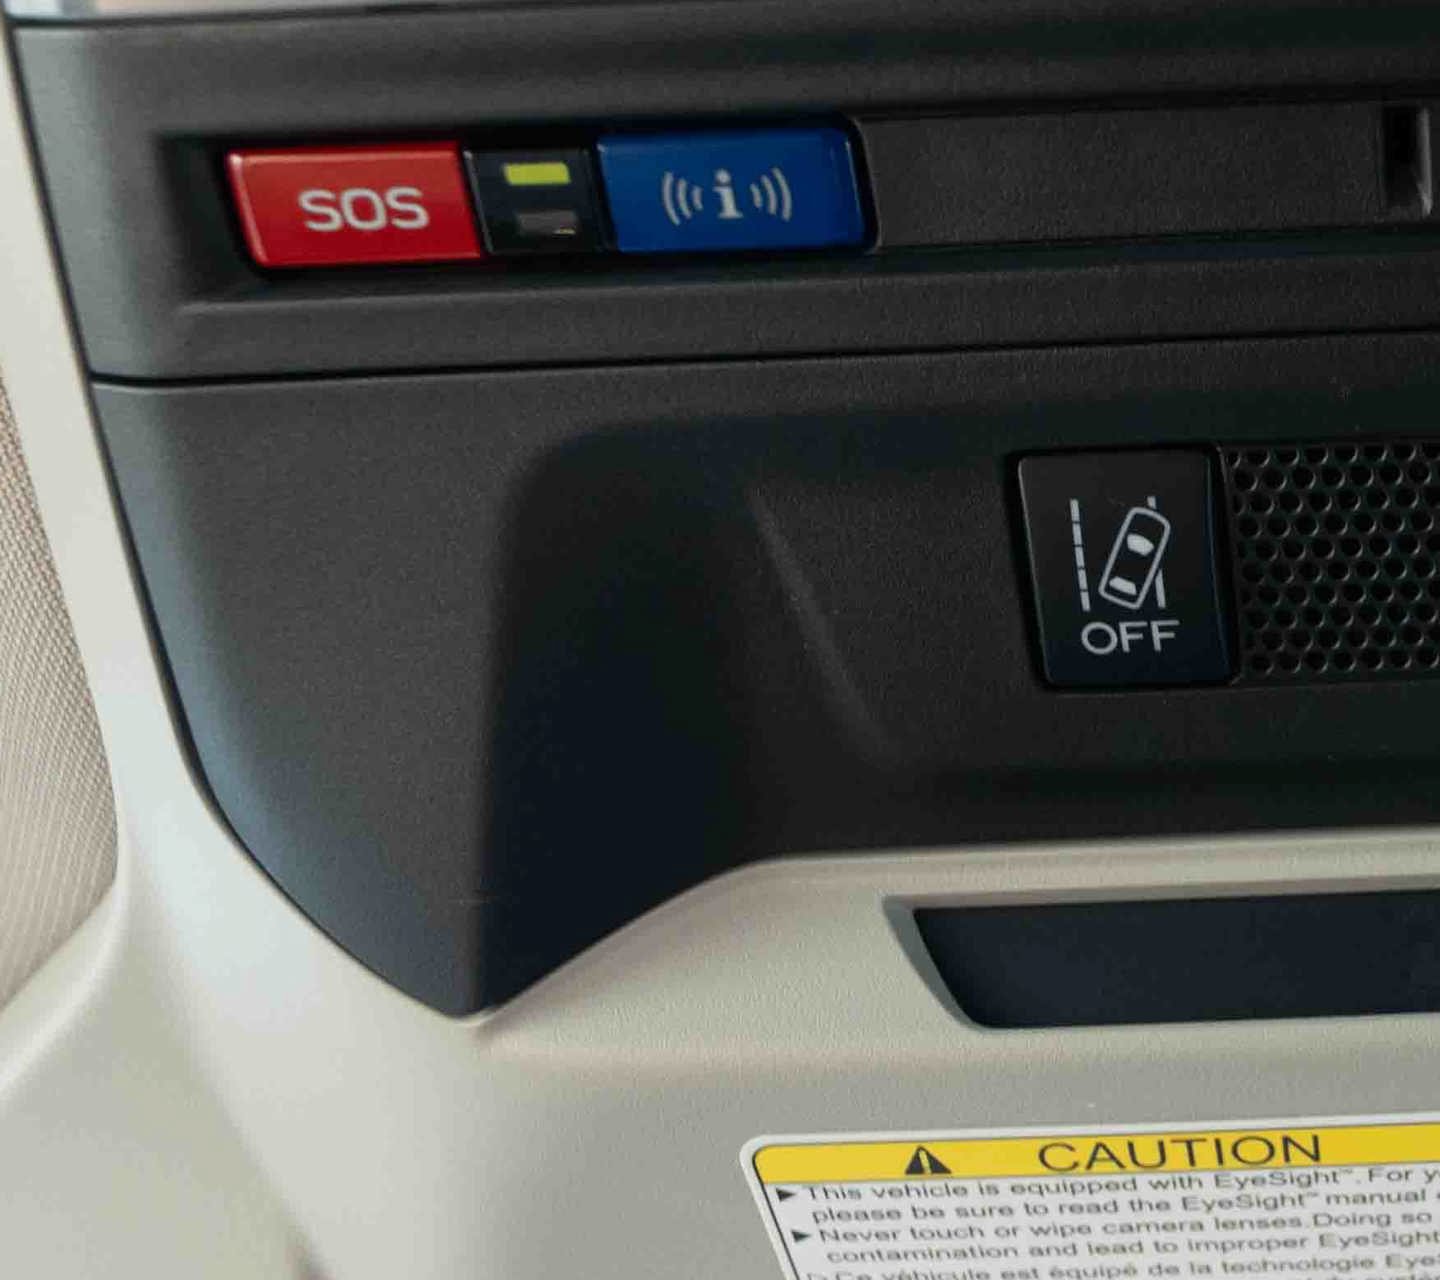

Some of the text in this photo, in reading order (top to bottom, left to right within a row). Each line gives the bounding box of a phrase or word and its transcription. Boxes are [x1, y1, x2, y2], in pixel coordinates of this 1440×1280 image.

[297, 186, 430, 232] SOS
[1080, 619, 1181, 655] OFF
[1038, 1133, 1322, 1170] CAUTION
[808, 1185, 863, 1201] This
[871, 1181, 969, 1199] vehicle
[978, 1180, 1000, 1196] is
[1010, 1176, 1138, 1197] equipped
[1148, 1175, 1203, 1191] with
[1367, 1166, 1412, 1183] For
[811, 1207, 902, 1225] please
[911, 1205, 946, 1220] be
[956, 1205, 1014, 1219] sure
[1024, 1202, 1049, 1216] to
[1059, 1198, 1119, 1215] read
[1129, 1197, 1171, 1213] the
[1326, 1187, 1426, 1206] manual
[820, 1228, 899, 1243] Never
[910, 1223, 984, 1240] touch
[994, 1224, 1018, 1237] or
[1030, 1220, 1092, 1238] wipe
[1102, 1219, 1204, 1235] camera
[1401, 1211, 1433, 1223] so
[827, 1243, 1018, 1263] contamination
[1029, 1241, 1078, 1257] and
[1087, 1239, 1143, 1256] lead
[1153, 1239, 1178, 1253] to
[1187, 1235, 1308, 1254] improper
[1000, 1267, 1039, 1280] est
[1148, 1261, 1180, 1275] de
[1190, 1260, 1211, 1274] la
[1221, 1255, 1375, 1273] technologie
